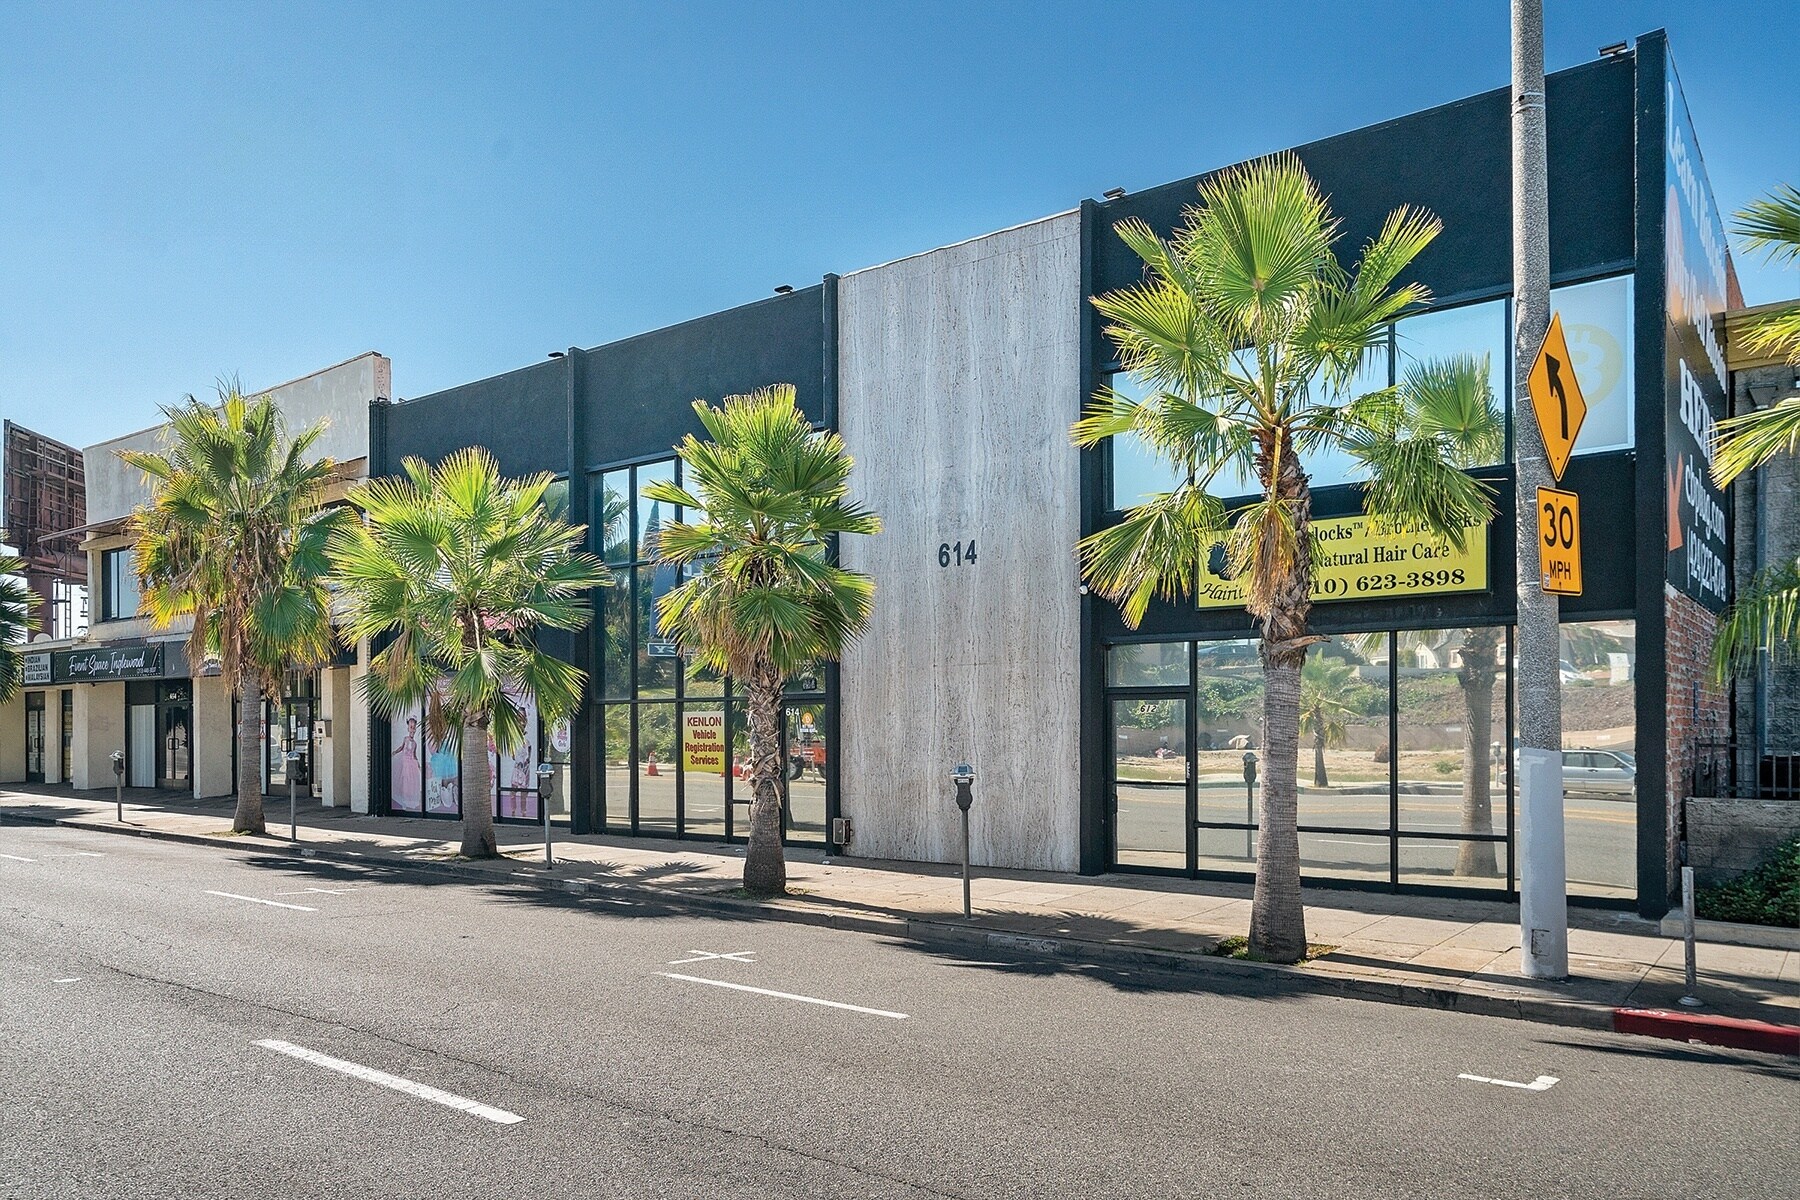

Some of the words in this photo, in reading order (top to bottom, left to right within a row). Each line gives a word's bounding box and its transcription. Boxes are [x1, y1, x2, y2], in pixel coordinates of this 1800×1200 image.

[1668, 81, 1698, 228] Learn
[1543, 502, 1573, 549] 30
[938, 540, 977, 567] 614
[1373, 545, 1407, 563] Hair
[1412, 542, 1450, 560] Care
[1549, 560, 1571, 580] MPH
[1311, 577, 1348, 596] 10)
[1356, 568, 1466, 592] 623-3898
[1200, 583, 1247, 601] Hairit
[68, 655, 88, 676] Event
[88, 654, 108, 676] Space
[108, 651, 145, 675] Inglewood
[785, 707, 800, 716] 614
[1140, 705, 1157, 713] 612
[687, 716, 722, 727] KENLON
[692, 730, 717, 740] Vehicle
[684, 742, 724, 754] Registration
[690, 755, 719, 766] Services
